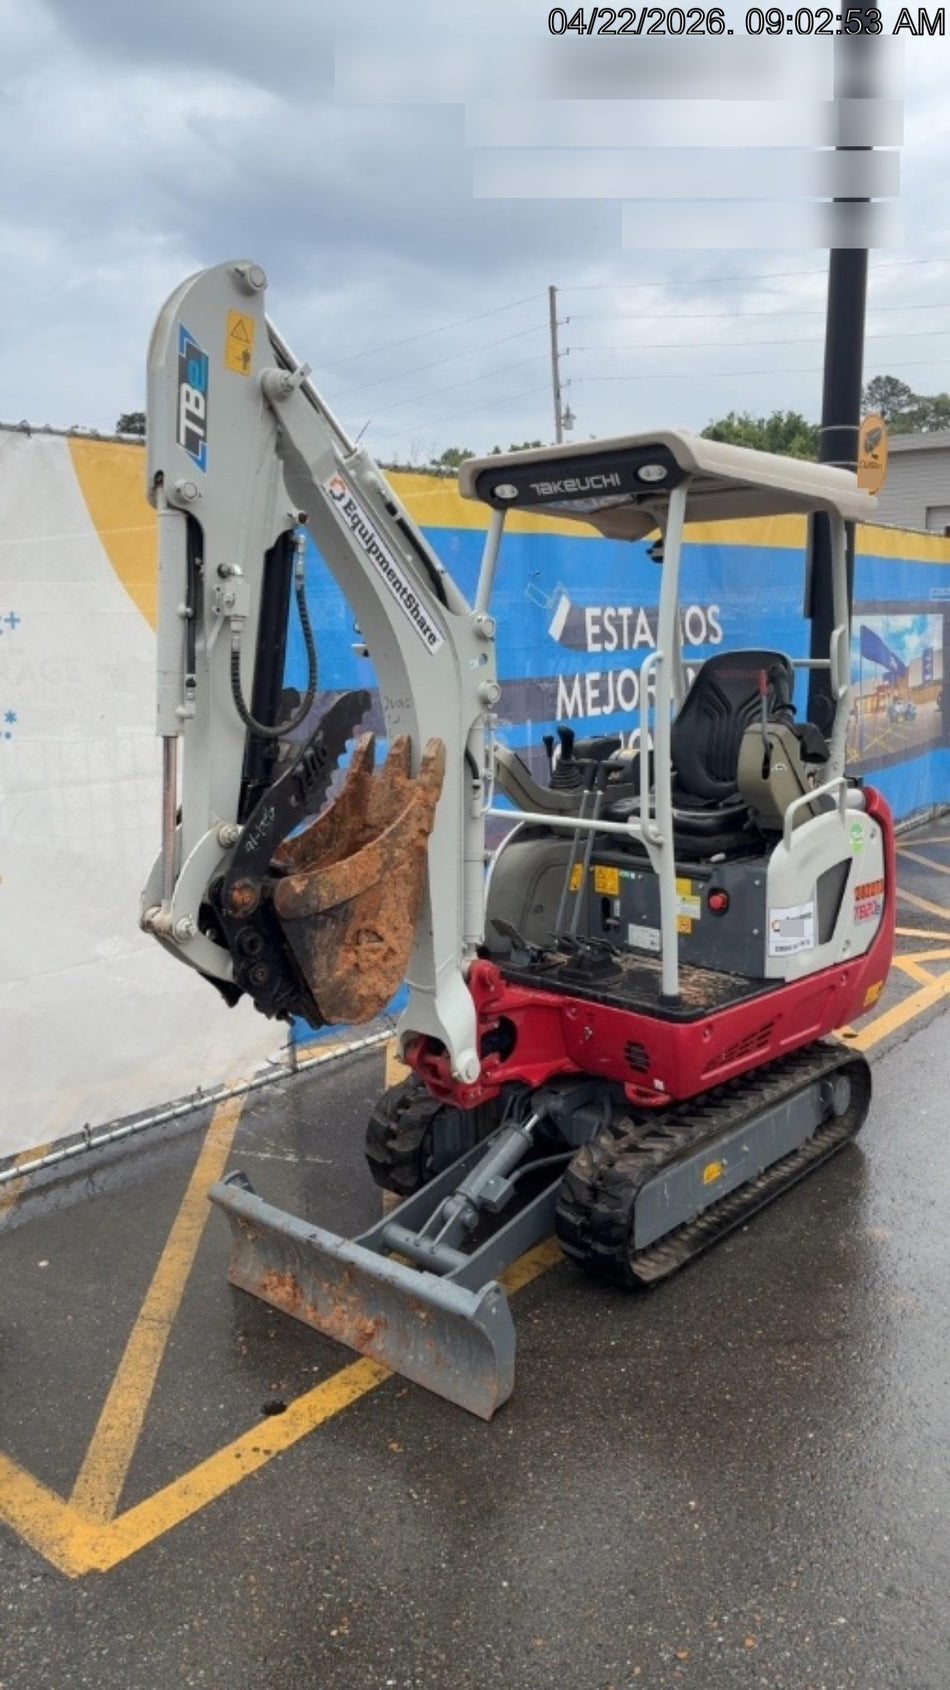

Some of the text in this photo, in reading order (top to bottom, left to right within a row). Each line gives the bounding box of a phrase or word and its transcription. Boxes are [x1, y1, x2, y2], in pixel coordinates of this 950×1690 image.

[180, 355, 208, 446] TB2
[530, 473, 621, 496] TAKEUCHI
[343, 500, 437, 646] EquipmentShare
[585, 605, 723, 653] ESTAOS
